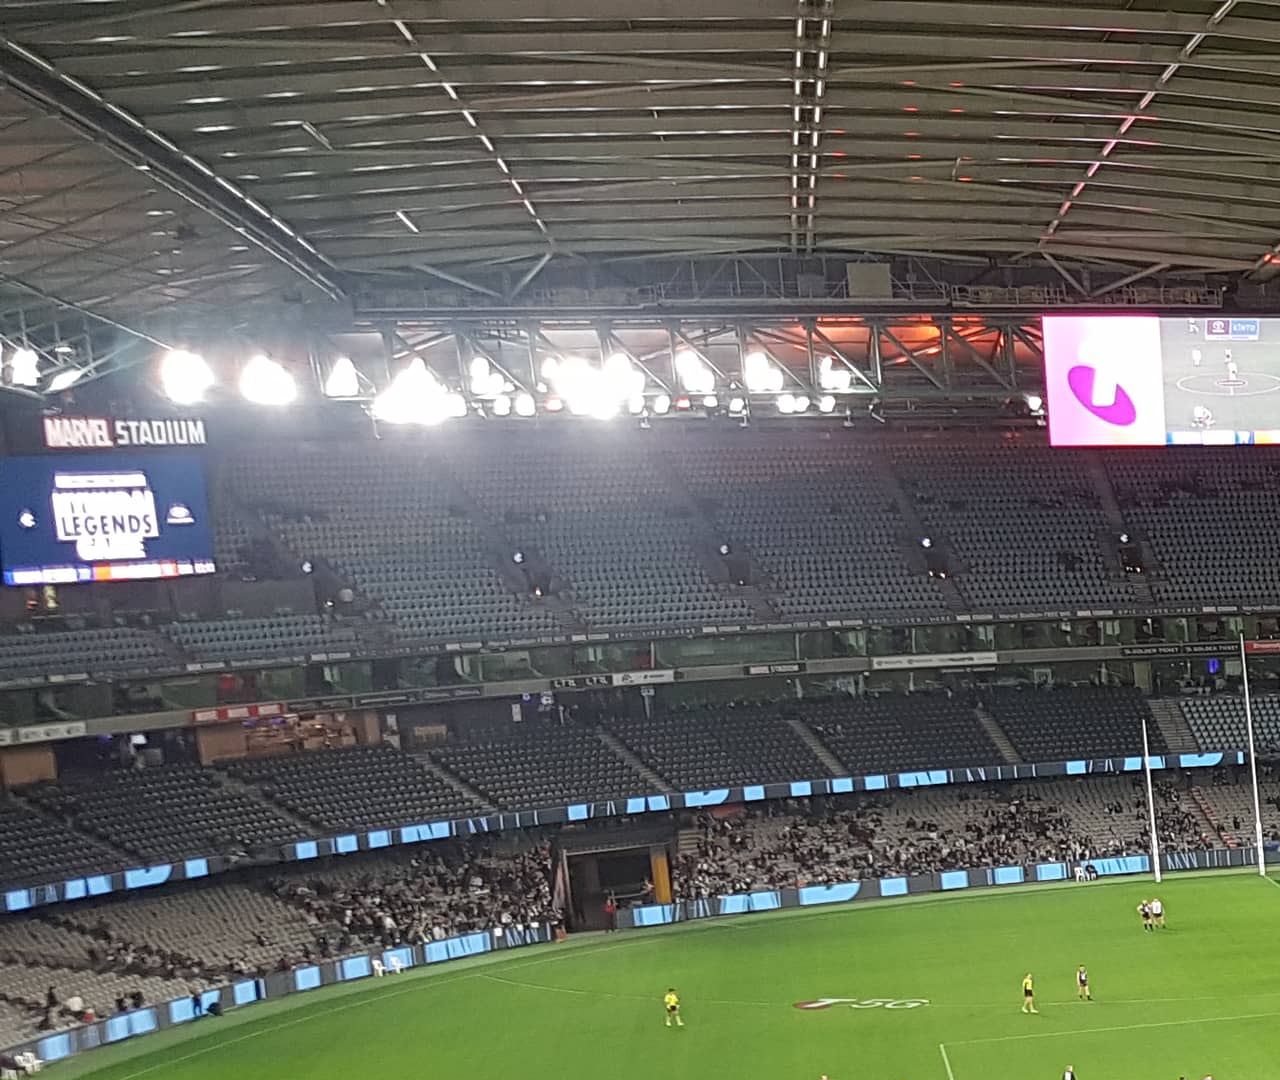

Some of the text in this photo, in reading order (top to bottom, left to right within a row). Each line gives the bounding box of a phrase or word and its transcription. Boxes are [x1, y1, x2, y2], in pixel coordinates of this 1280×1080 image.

[44, 418, 207, 447] MARVEL STADIUM
[61, 513, 153, 538] LEGENDS
